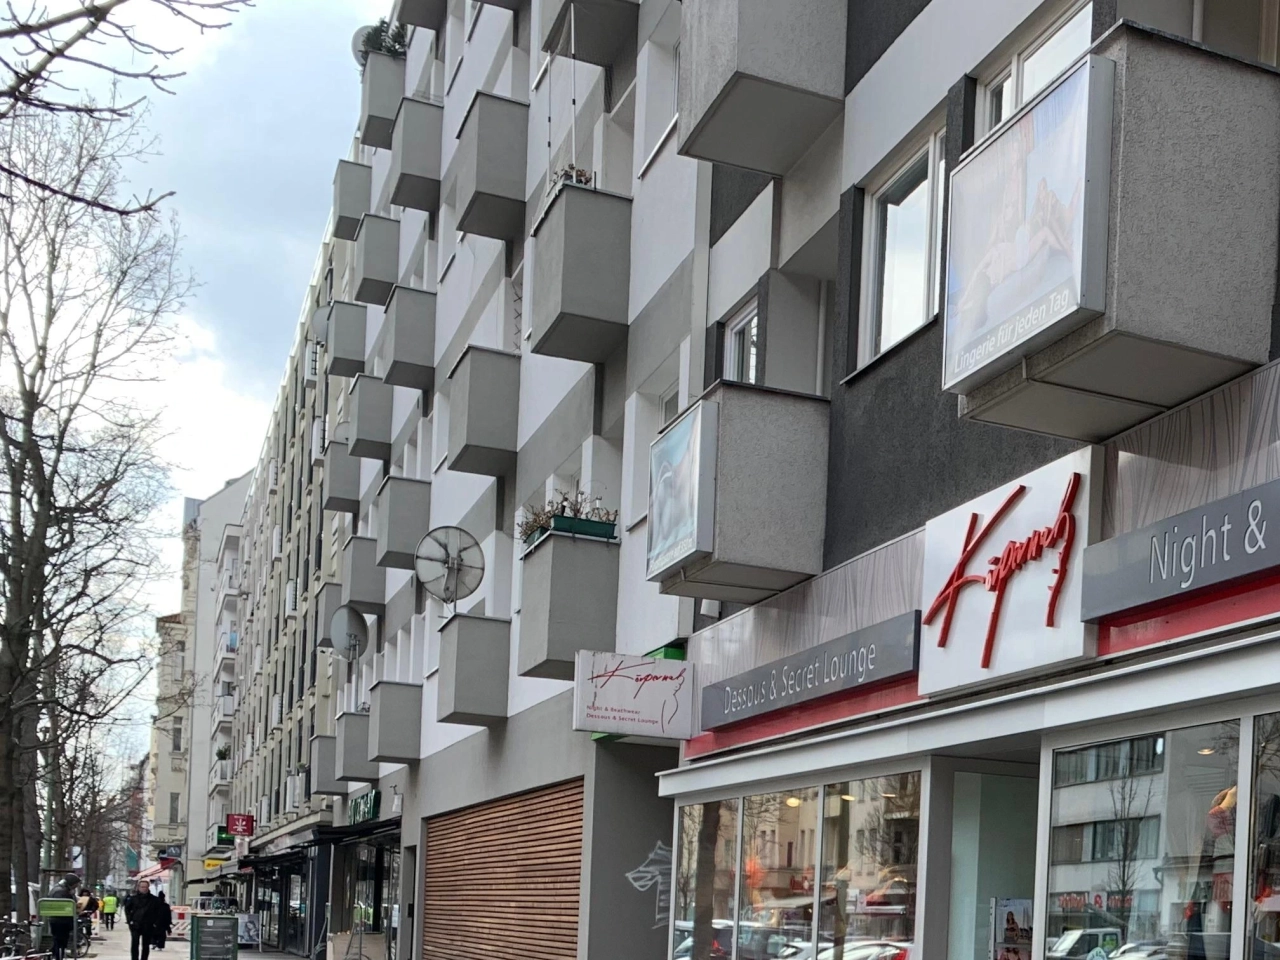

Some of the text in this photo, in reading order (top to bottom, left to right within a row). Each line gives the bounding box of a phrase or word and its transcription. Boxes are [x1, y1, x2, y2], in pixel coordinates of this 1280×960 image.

[954, 288, 1070, 374] Lingerie für jeden Tag
[1149, 513, 1233, 589] Night
[1243, 499, 1267, 555] &
[586, 704, 602, 713] Night
[724, 642, 877, 714] Dessous & Secret Lounge
[586, 712, 611, 721] Dessous
[618, 715, 636, 723] Secret
[638, 717, 659, 725] Lounge
